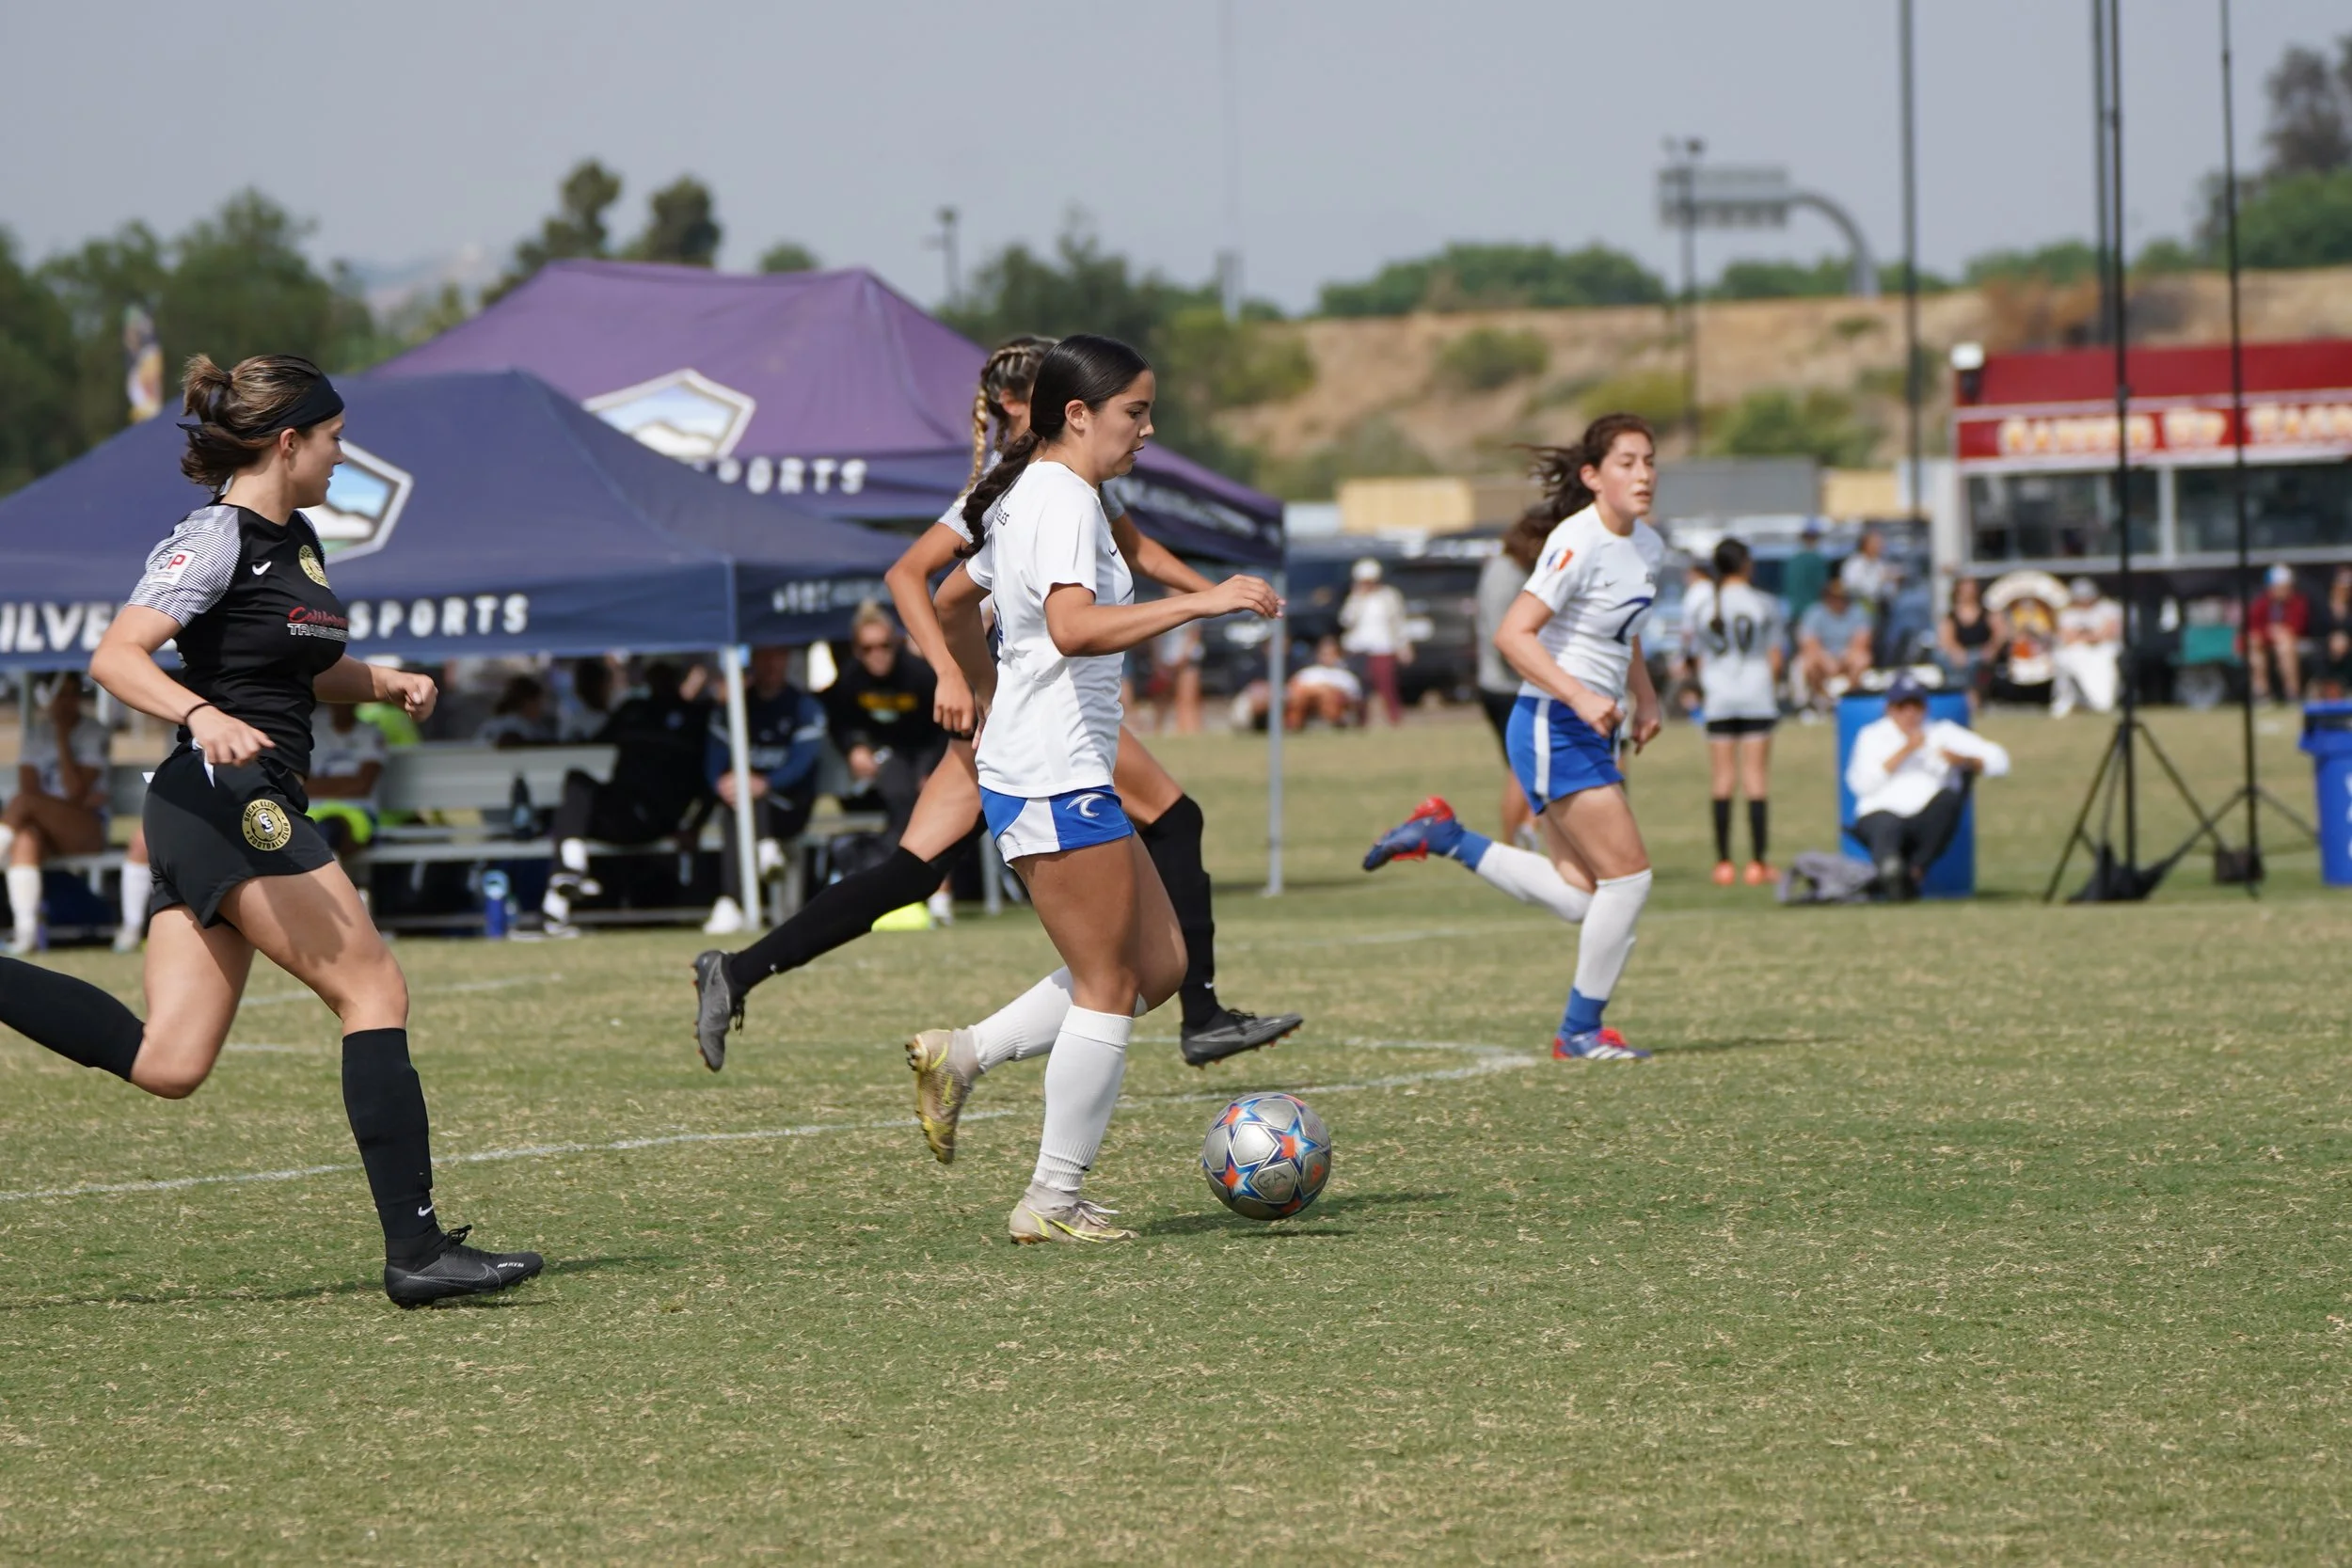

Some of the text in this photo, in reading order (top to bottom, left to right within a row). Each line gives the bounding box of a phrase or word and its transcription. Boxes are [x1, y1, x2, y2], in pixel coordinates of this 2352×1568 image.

[694, 456, 867, 495] PORTS
[0, 593, 530, 654] ILVE SPORTS
[260, 800, 278, 812] ELITE
[248, 835, 283, 849] FOOTBALL
[281, 822, 290, 841] CLUB
